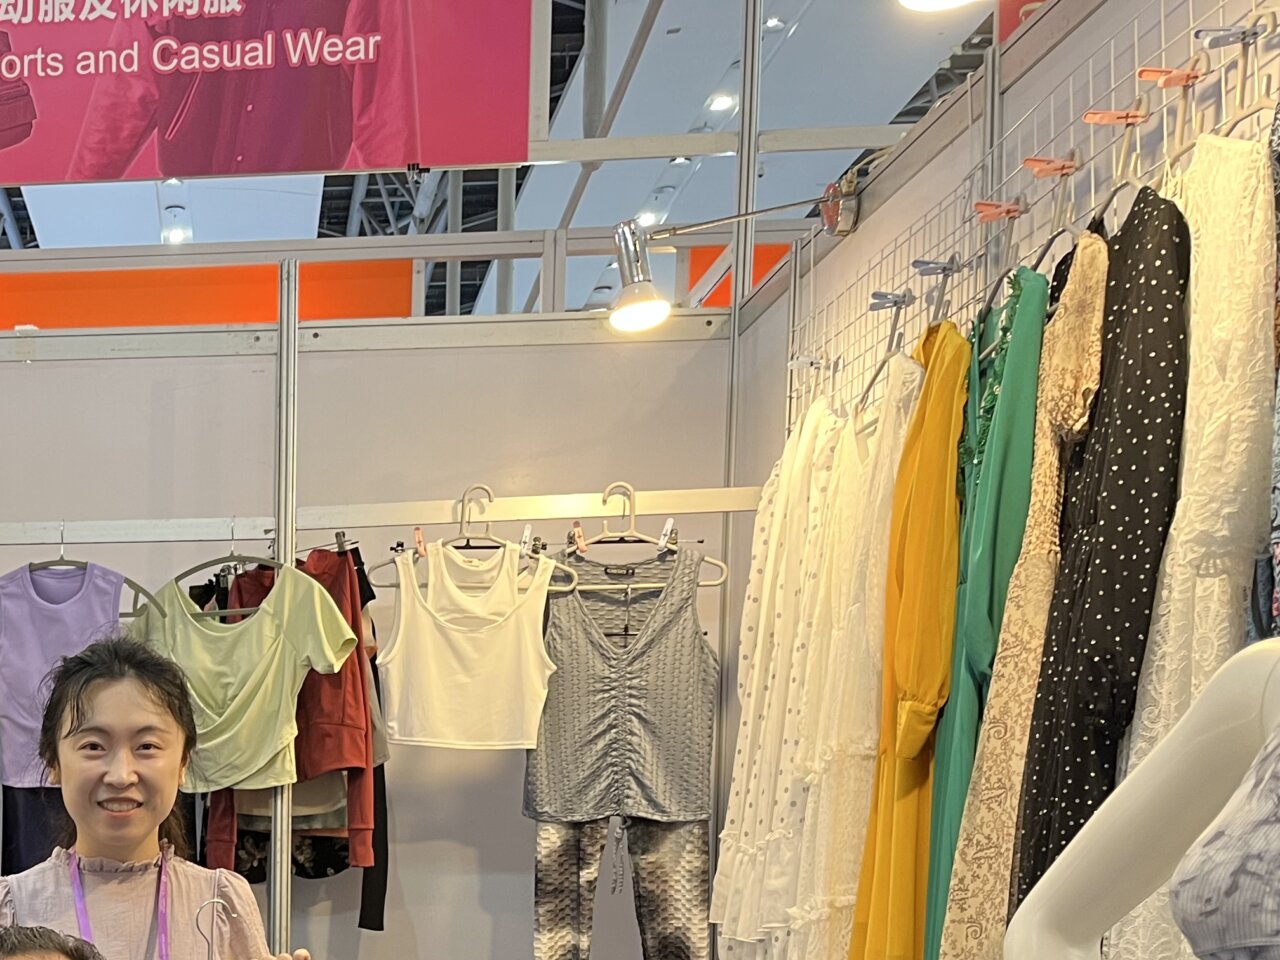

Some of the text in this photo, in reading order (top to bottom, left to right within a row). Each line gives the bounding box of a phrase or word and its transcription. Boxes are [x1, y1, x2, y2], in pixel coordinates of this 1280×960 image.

[75, 41, 139, 75] and
[152, 33, 273, 71] Casual
[285, 31, 382, 64] Wear
